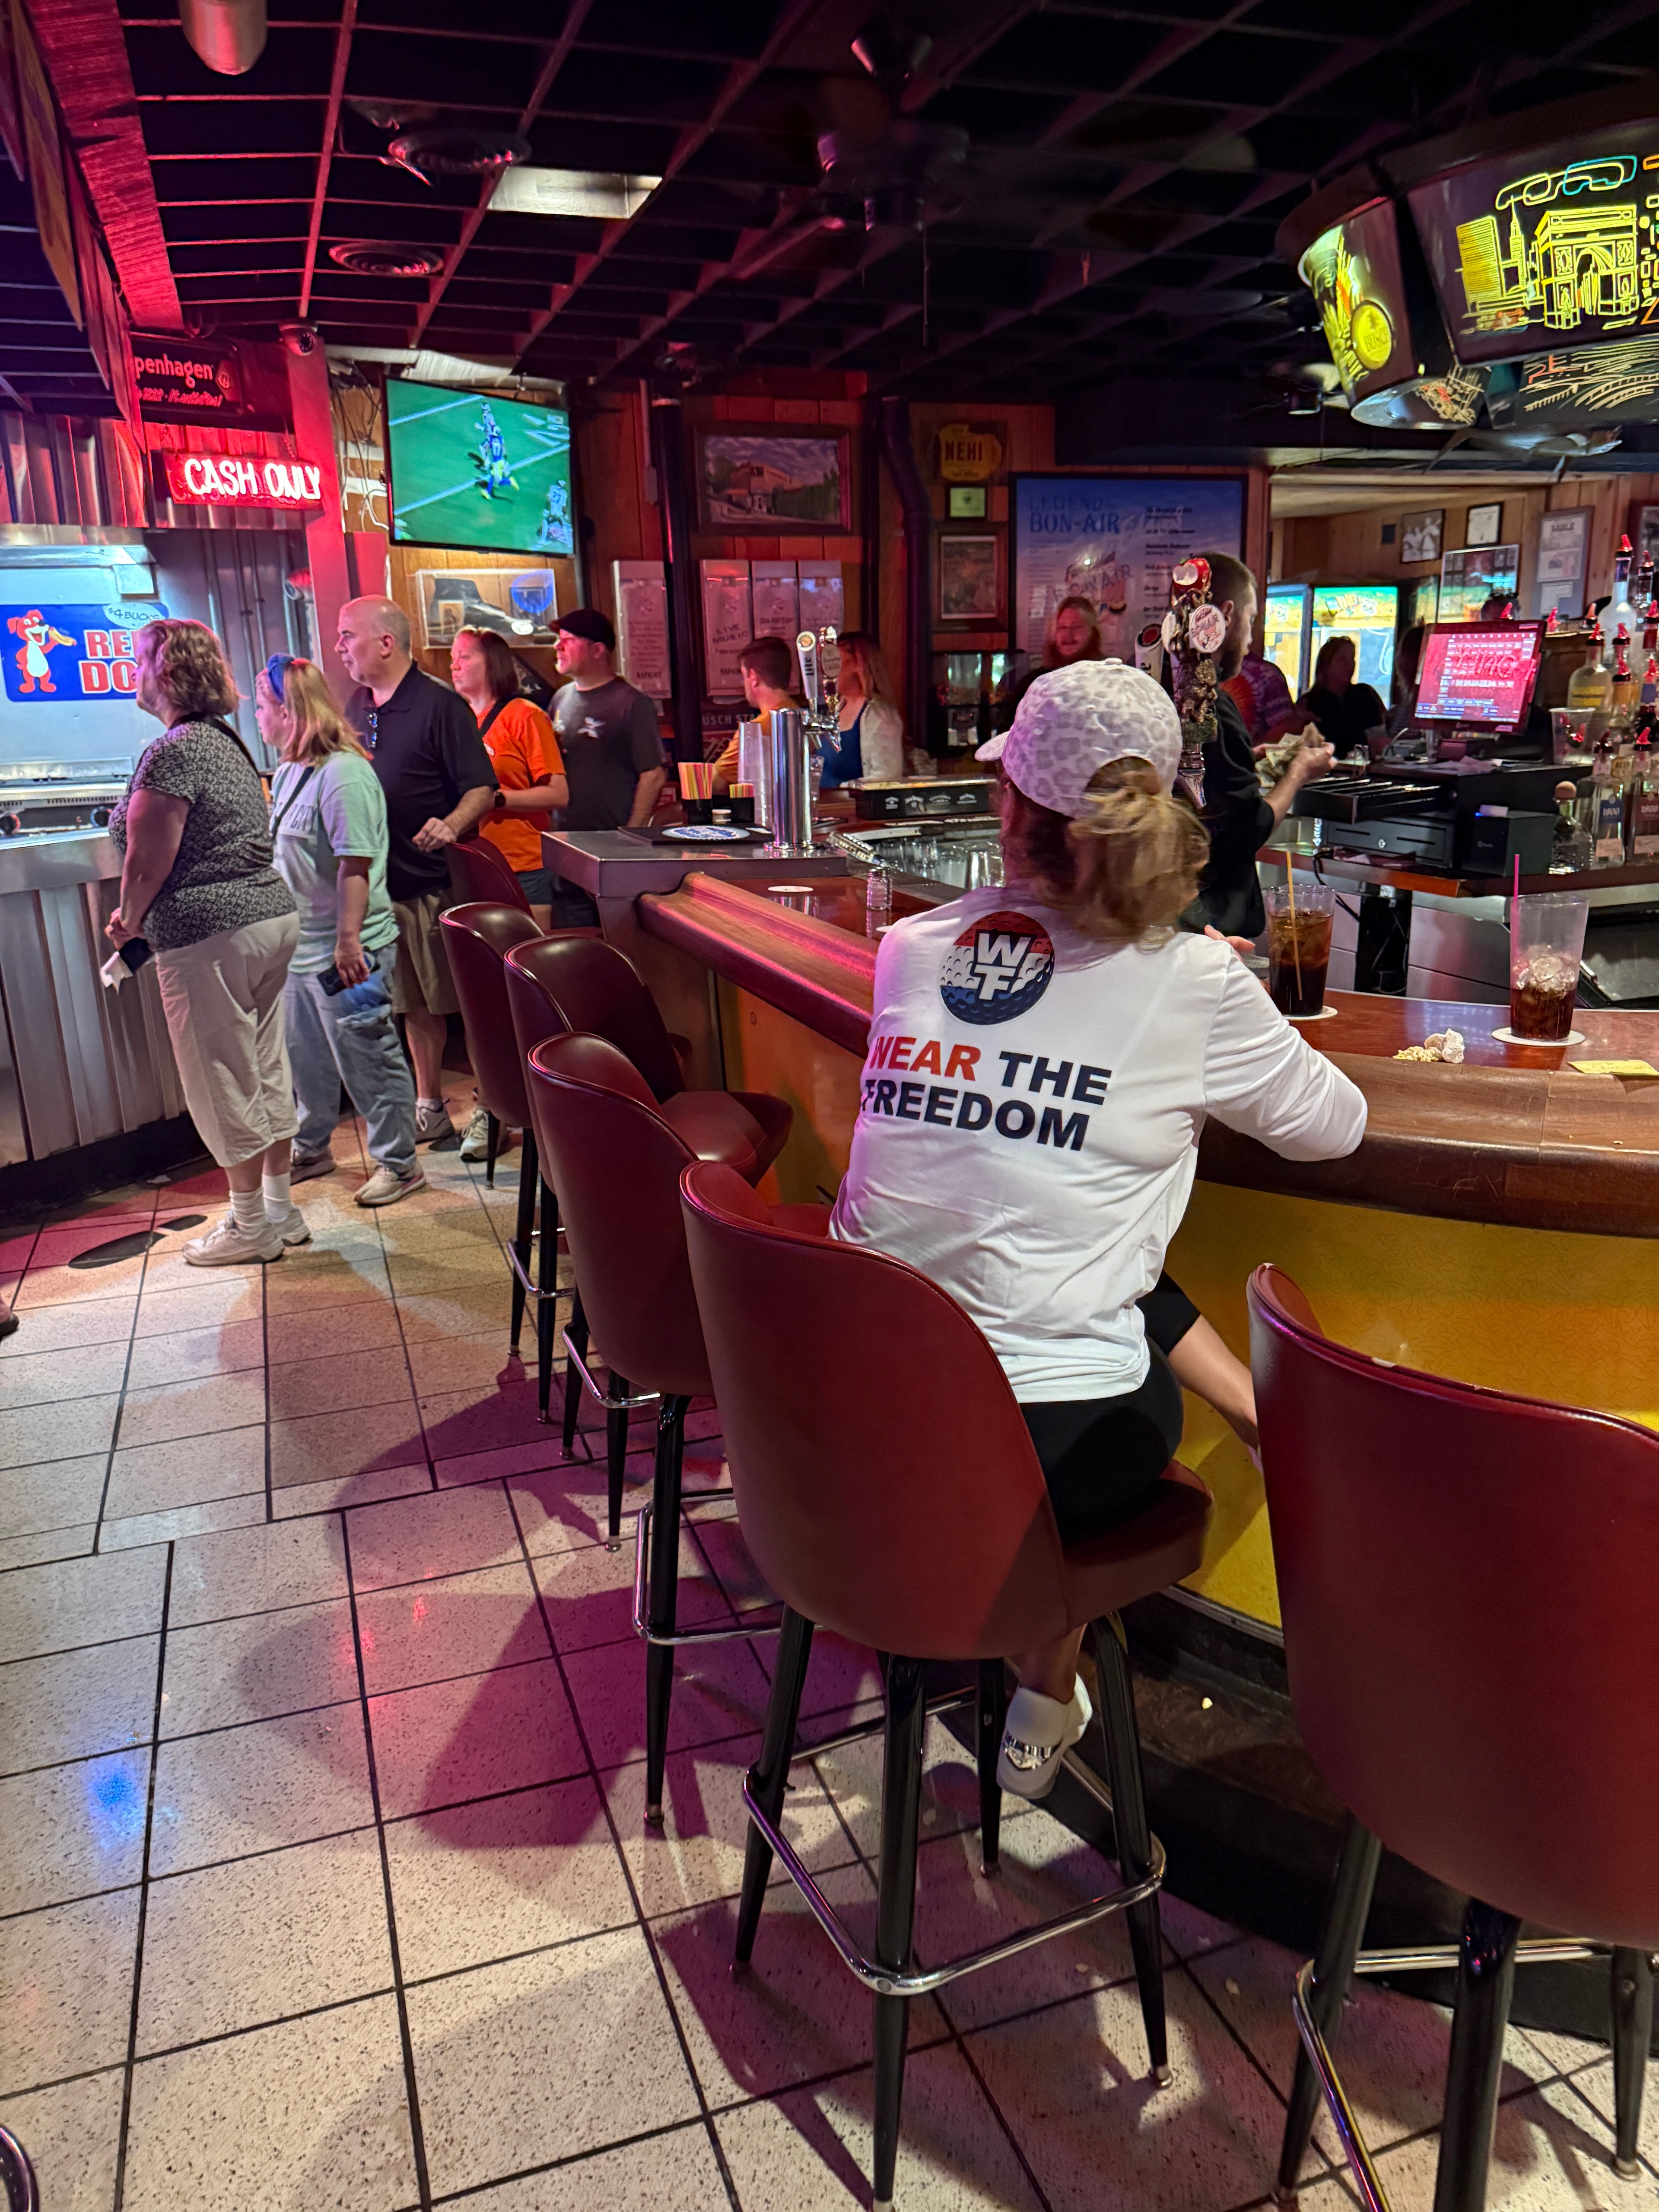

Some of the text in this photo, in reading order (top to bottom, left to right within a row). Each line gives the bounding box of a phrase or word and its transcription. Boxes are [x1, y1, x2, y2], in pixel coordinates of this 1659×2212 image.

[134, 353, 213, 388] penhagen
[945, 441, 982, 461] NEHI
[184, 458, 321, 499] CASH ONLY
[1030, 512, 1120, 533] BON-AIR
[78, 659, 138, 694] DO
[702, 714, 731, 725] USCH
[1603, 807, 1620, 817] 1800
[999, 1051, 1112, 1106] THE
[861, 1079, 1090, 1151] FREEDOM
